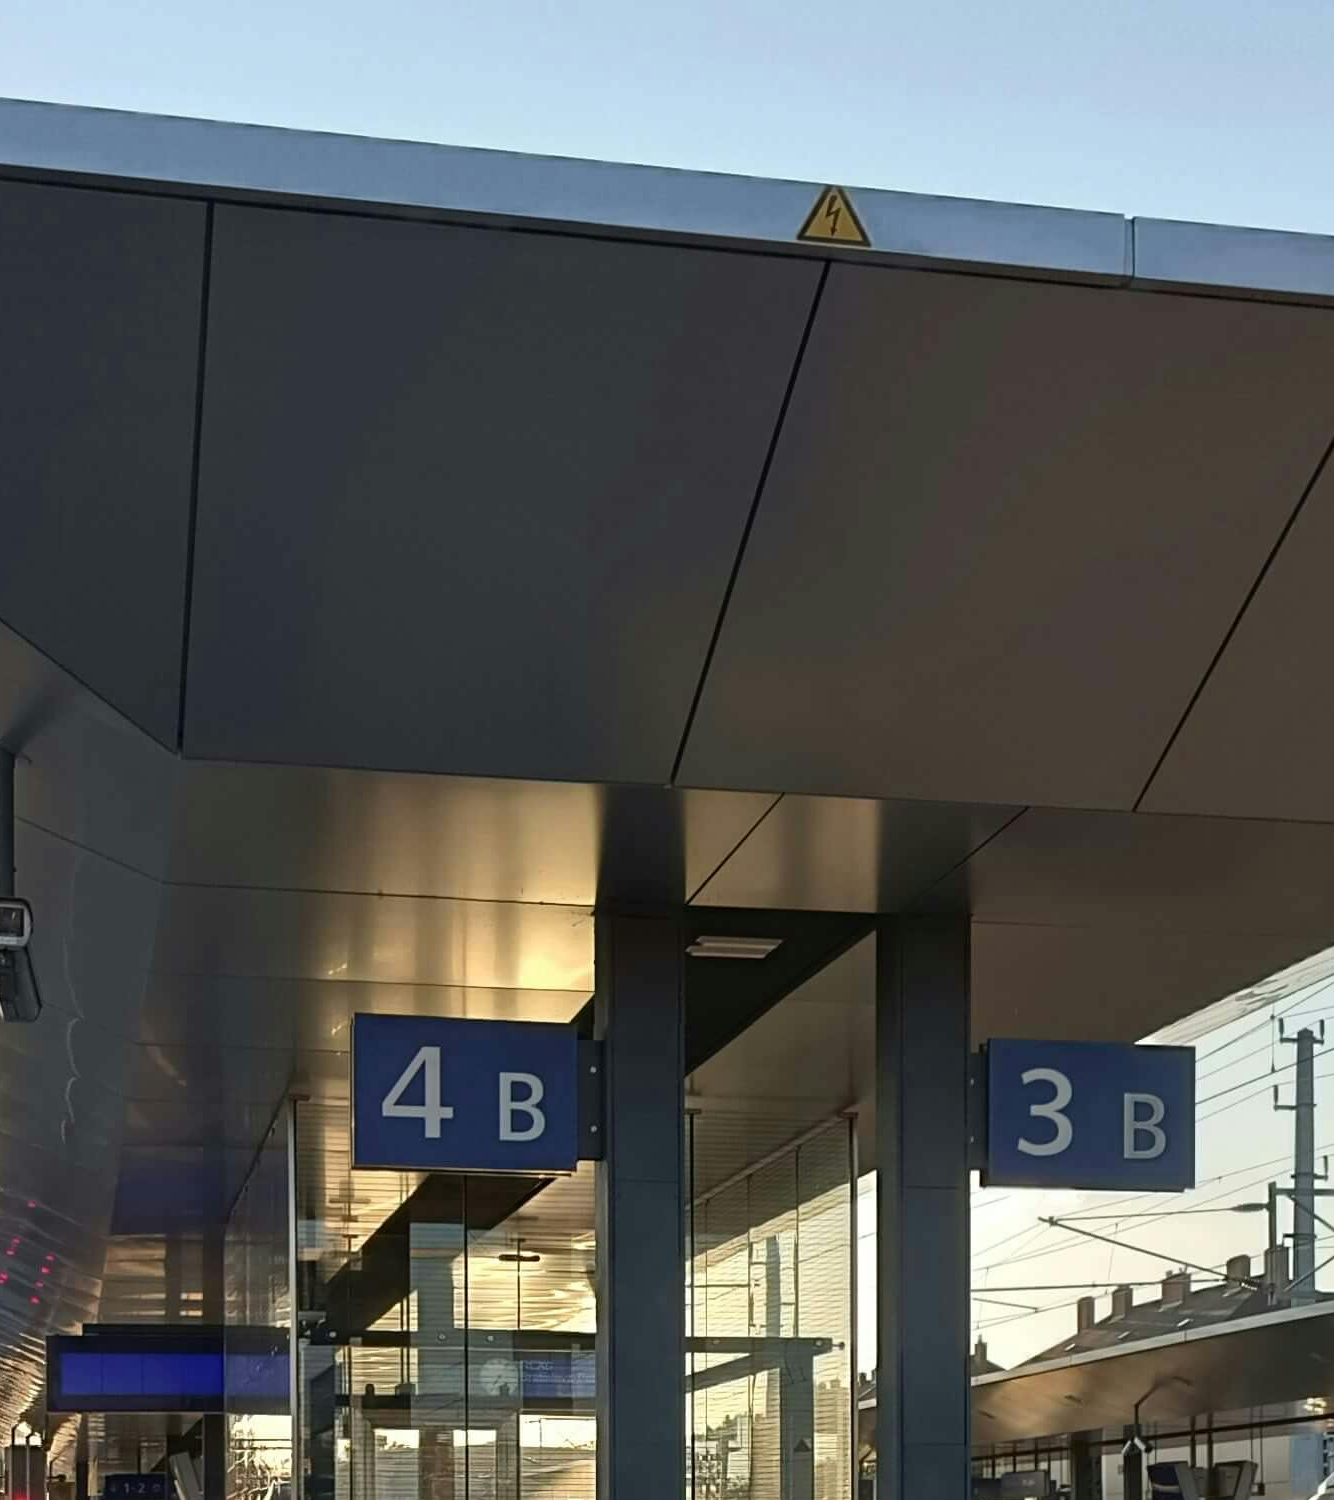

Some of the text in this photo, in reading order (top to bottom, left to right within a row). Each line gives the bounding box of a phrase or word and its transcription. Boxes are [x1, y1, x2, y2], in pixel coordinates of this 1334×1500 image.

[381, 1045, 546, 1141] 4 B
[1017, 1067, 1166, 1160] 3 B
